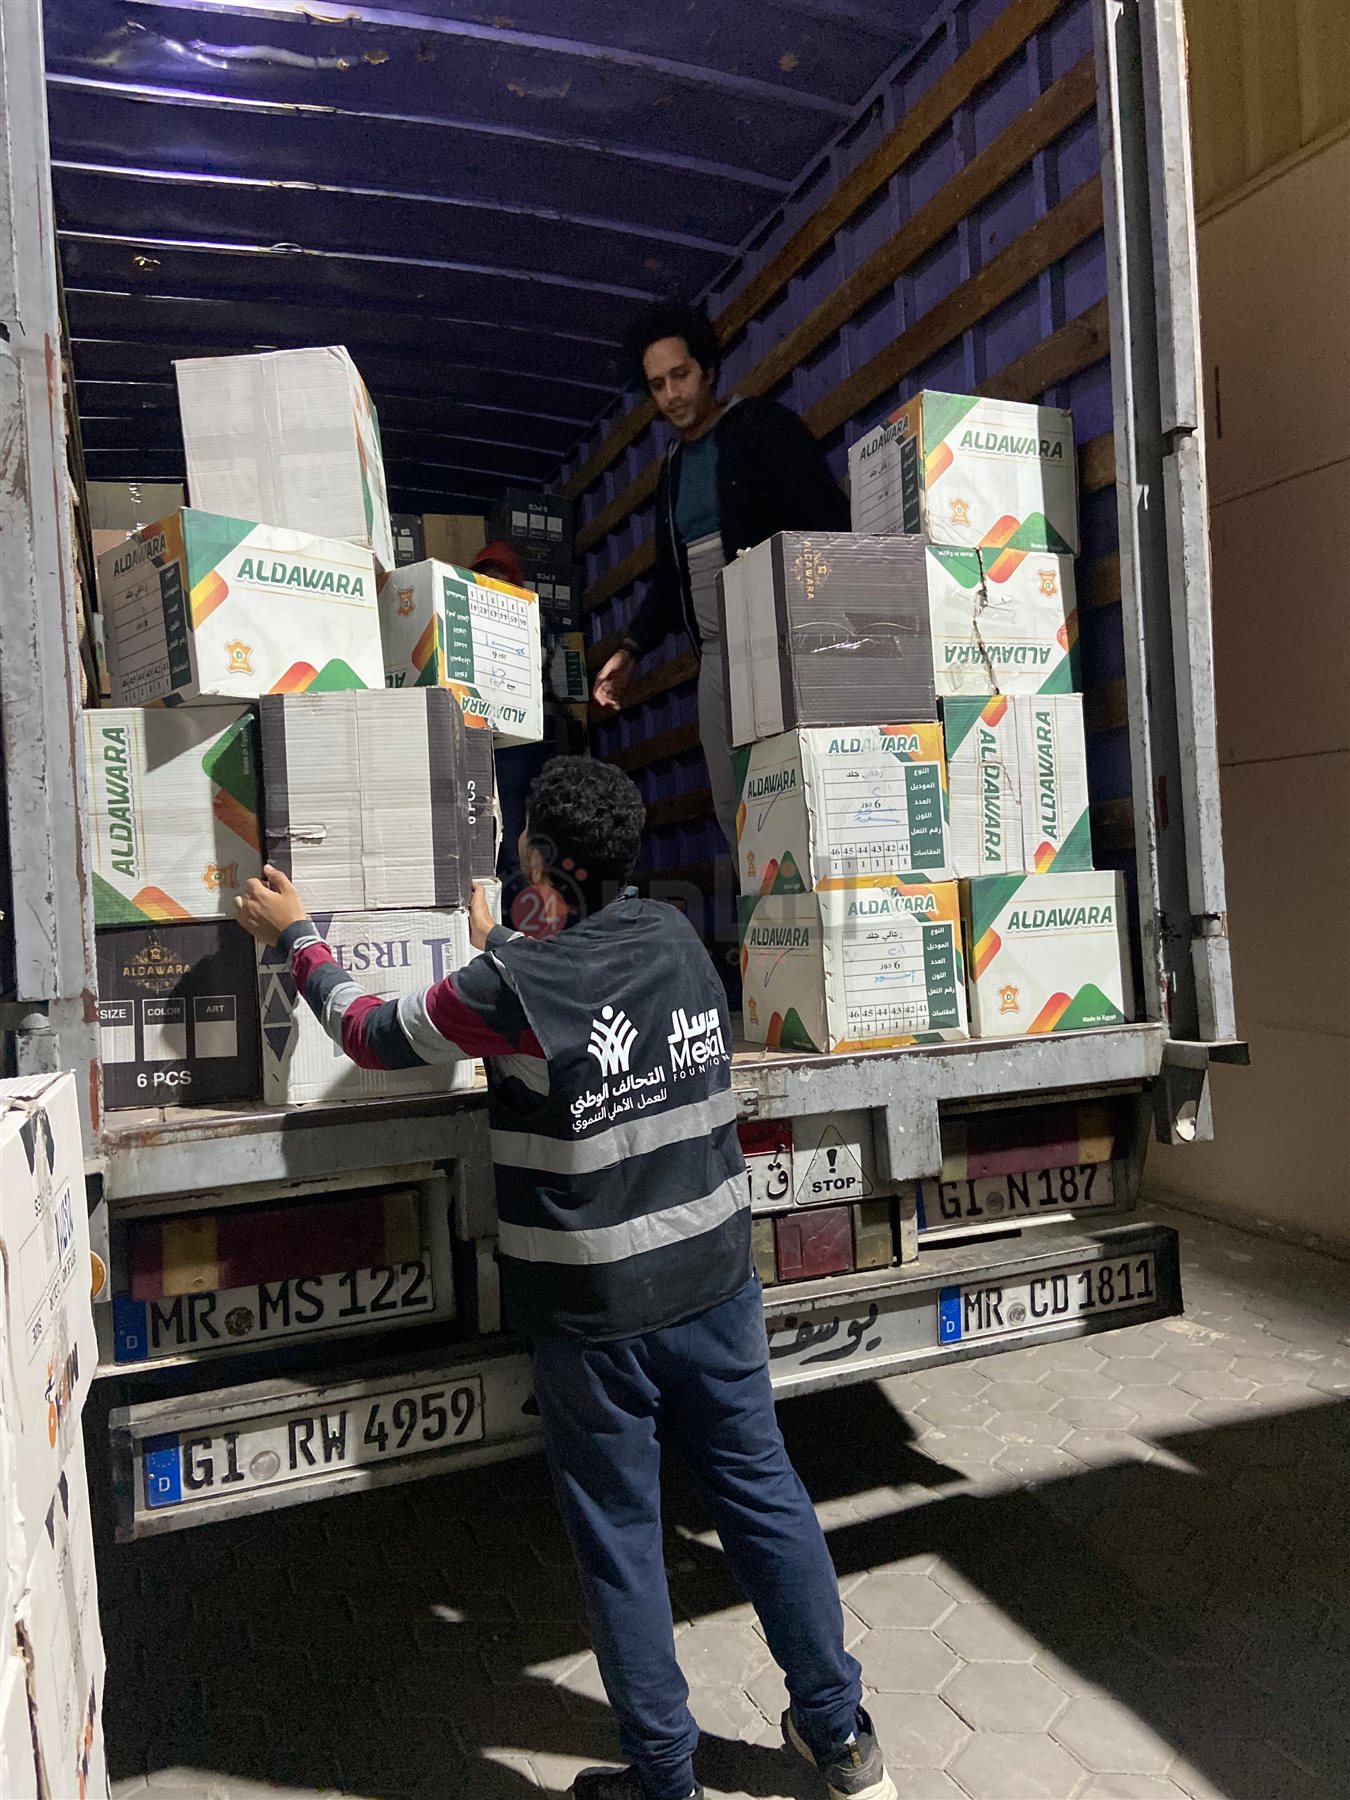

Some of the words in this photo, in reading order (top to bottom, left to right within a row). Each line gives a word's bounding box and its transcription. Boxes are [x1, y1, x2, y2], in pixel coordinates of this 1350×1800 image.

[860, 414, 909, 462] ALDAWARA
[960, 430, 1063, 459] ALDAWARA
[113, 533, 167, 578] ALDAWARA
[237, 558, 364, 597] ALDAWARA
[803, 541, 815, 600] ALDAWARA
[470, 603, 477, 611] 41
[479, 606, 487, 614] 42
[489, 609, 498, 618] 43
[499, 611, 508, 620] 44
[510, 615, 518, 623] 45
[519, 618, 527, 626] 46
[154, 665, 161, 675] 42
[914, 768, 930, 777] النوع
[1035, 712, 1058, 840] ALDAWARA
[748, 768, 796, 799] ALDAWARA
[910, 783, 935, 791] الموديل
[102, 727, 135, 878] ALDAWARA
[979, 729, 1001, 861] ALDAWARA
[874, 799, 881, 809] 6
[915, 812, 932, 820] اللون
[929, 827, 941, 835] رقم
[830, 848, 840, 856] 46
[843, 847, 854, 855] 45
[857, 846, 868, 854] 44
[871, 845, 882, 853] 43
[885, 844, 896, 852] 42
[899, 843, 909, 851] 41
[914, 849, 941, 857] المقاسات
[1007, 905, 1112, 930] ALDAWARA
[750, 927, 809, 947] ALDAWARA
[930, 927, 944, 936] النوع
[927, 941, 949, 951] الموديل
[894, 960, 901, 970] 6
[930, 957, 946, 965] العدد
[122, 964, 192, 977] ALDAWARA
[931, 972, 947, 980] اللون
[100, 1008, 127, 1019] SIZE
[147, 1007, 181, 1016] COLOR
[206, 1004, 225, 1013] ART
[849, 1011, 860, 1019] 46
[862, 1009, 874, 1017] 45
[877, 1008, 888, 1016] 44
[891, 1007, 902, 1015] 43
[904, 1006, 915, 1014] 42
[918, 1004, 927, 1012] 41
[1102, 1014, 1117, 1022] Egypt
[853, 1024, 857, 1032] 1
[136, 1073, 148, 1087] 6
[153, 1070, 192, 1086] PCS
[612, 1065, 666, 1096] التحالف
[570, 1082, 609, 1118] الوطني
[637, 1088, 667, 1109] للعمل
[608, 1097, 634, 1120] الأهلي
[572, 1106, 607, 1132] التنموي
[767, 1162, 788, 1200] ق
[812, 1177, 856, 1193] STOP
[938, 1179, 983, 1219] GI
[1007, 1172, 1030, 1209] N
[1038, 1164, 1098, 1205] 187
[964, 1286, 1003, 1332] MR
[1030, 1274, 1069, 1318] CD
[1078, 1258, 1153, 1309] 1811
[151, 1292, 220, 1349] MR
[258, 1276, 325, 1330] MS
[338, 1261, 427, 1317] 122
[946, 1320, 955, 1333] D
[126, 1336, 137, 1349] D
[183, 1432, 245, 1490] GI
[288, 1410, 347, 1470] RW
[364, 1386, 475, 1452] 4959
[158, 1476, 170, 1492] D
